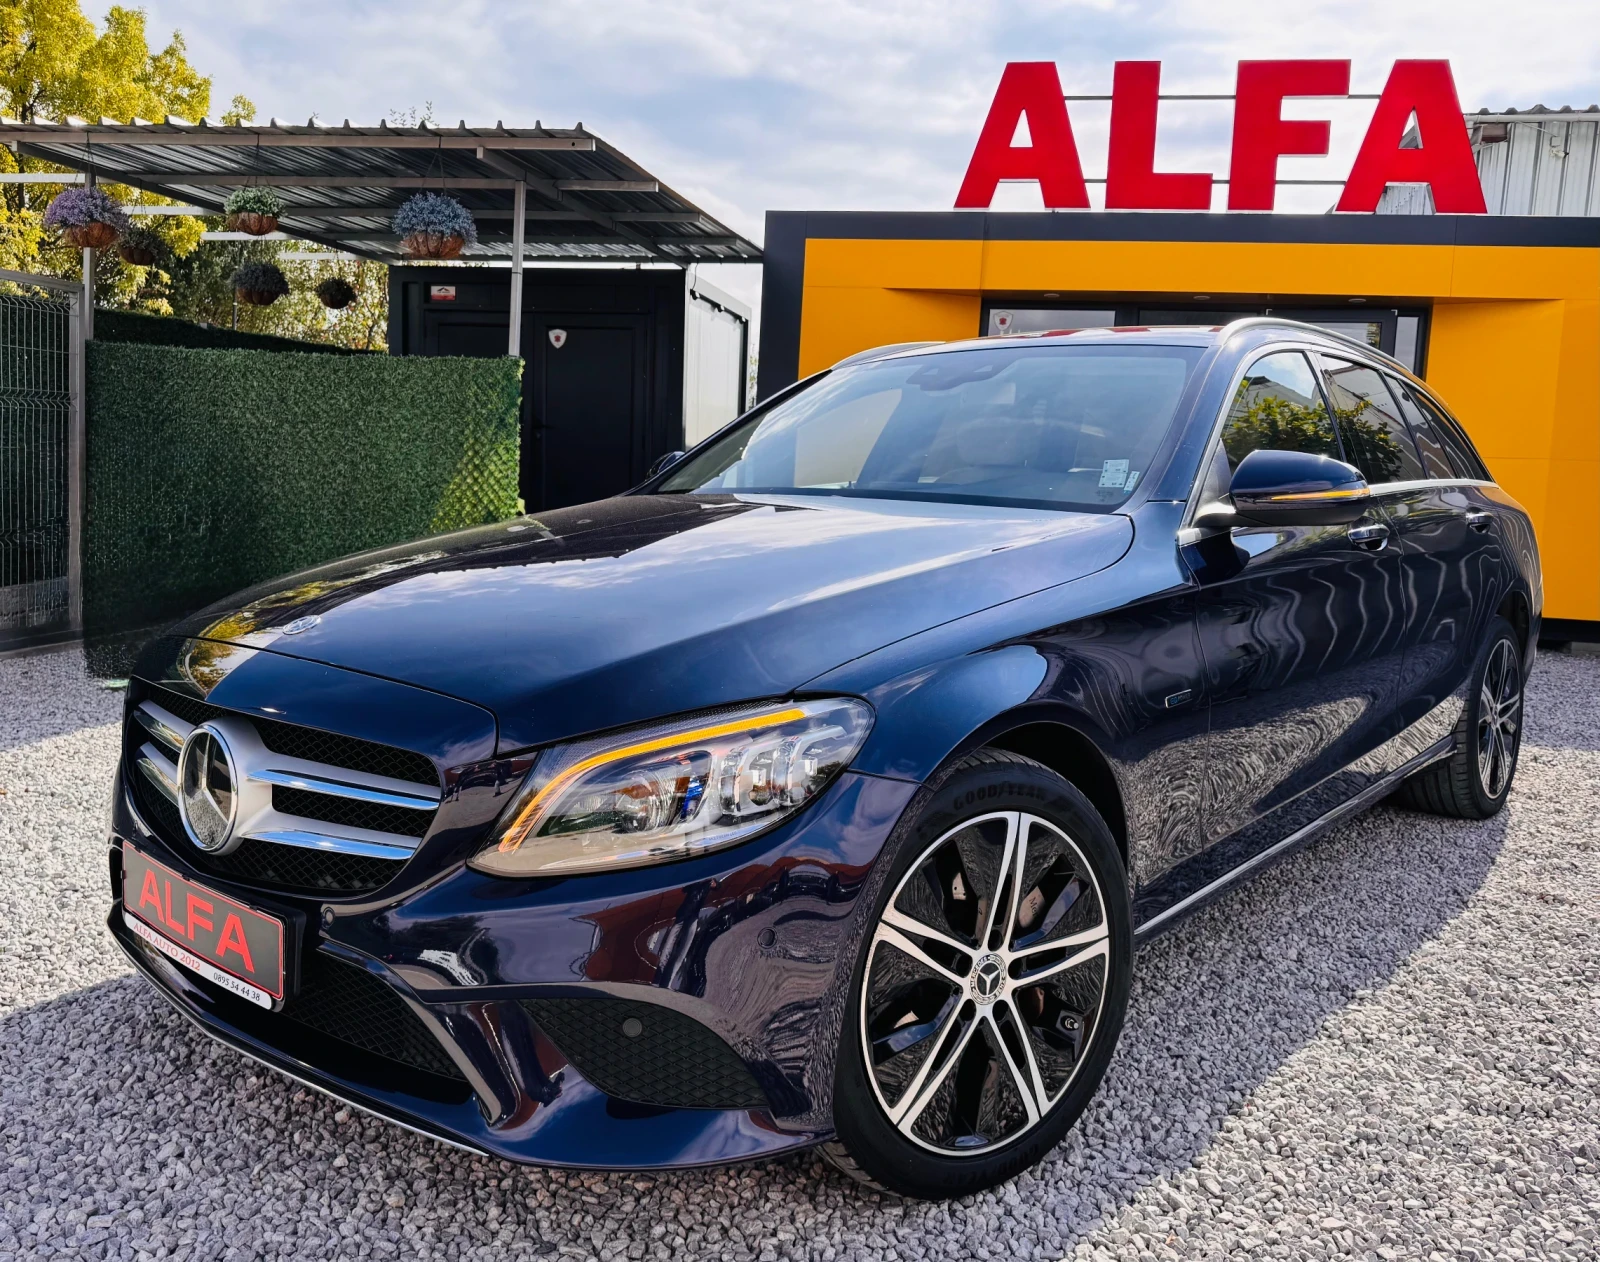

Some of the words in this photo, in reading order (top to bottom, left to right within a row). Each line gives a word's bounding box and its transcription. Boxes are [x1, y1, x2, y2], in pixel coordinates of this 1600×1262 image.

[953, 59, 1488, 213] ALFA
[133, 923, 152, 940] ALFA
[153, 937, 178, 957] AUTO
[180, 953, 200, 971] 2012
[139, 868, 255, 973] ALFA
[213, 972, 229, 986] 0895
[231, 981, 239, 991] 54
[241, 987, 250, 996] 44
[251, 991, 260, 1001] 38
